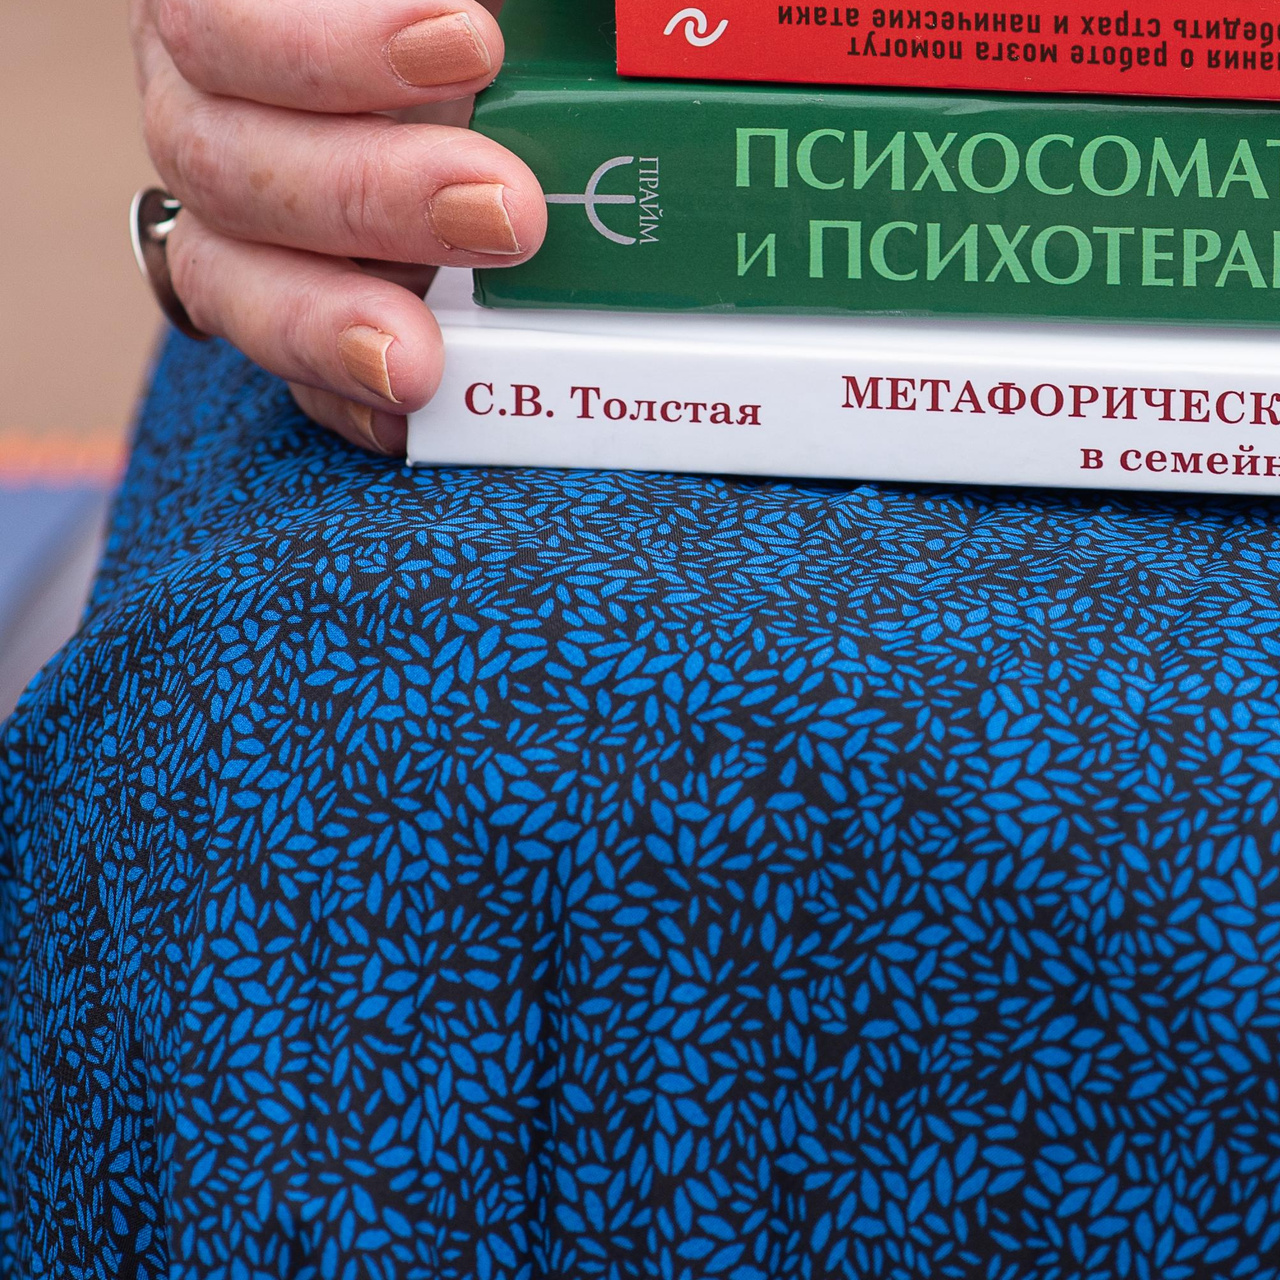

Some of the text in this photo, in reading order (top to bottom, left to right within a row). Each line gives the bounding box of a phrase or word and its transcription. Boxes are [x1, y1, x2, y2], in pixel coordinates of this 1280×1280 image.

[778, 5, 860, 27] атаки
[871, 6, 1041, 35] панические
[1054, 15, 1069, 35] и
[1081, 10, 1161, 38] страх
[847, 30, 963, 60] помогут
[975, 41, 1058, 63] мозга
[1070, 44, 1168, 73] работе
[1180, 48, 1194, 69] о
[639, 156, 664, 245] ПРАЙМ
[737, 232, 776, 277] и
[464, 382, 762, 426] С.В. Толстая
[1080, 448, 1104, 470] в
